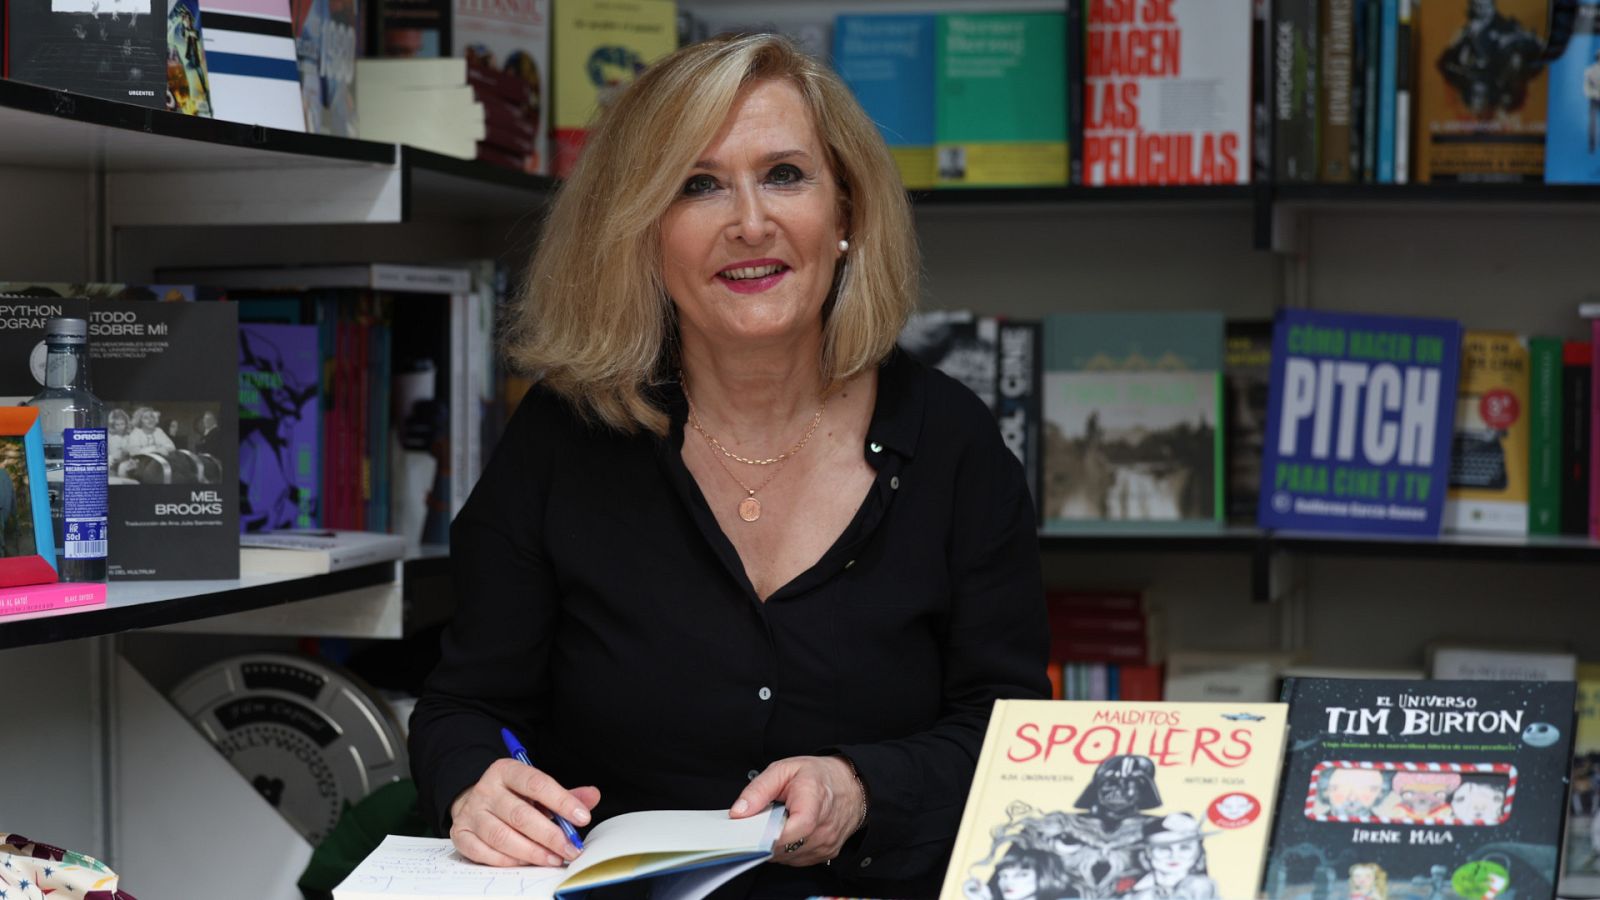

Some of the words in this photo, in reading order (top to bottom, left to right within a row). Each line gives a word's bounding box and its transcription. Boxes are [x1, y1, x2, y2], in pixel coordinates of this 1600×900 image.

[1085, 82, 1140, 130] LAS
[0, 305, 62, 316] PYTHON
[89, 324, 144, 336] SOBRE
[147, 321, 168, 336] MÍ!
[1278, 356, 1441, 467] PITCH
[1275, 462, 1329, 495] PARA
[1333, 466, 1381, 498] CINE
[1386, 470, 1399, 500] Y
[1405, 472, 1432, 502] TV
[191, 491, 222, 502] MEL
[155, 503, 222, 516] BROOKS
[1376, 696, 1393, 707] EL
[1398, 694, 1477, 708] UNIVERSO
[1092, 710, 1182, 727] MALDITOS
[1325, 706, 1391, 735] TIM
[1400, 708, 1524, 735] BURTON
[1007, 723, 1252, 768] SPOILERS
[221, 733, 331, 798] OLLYWOOD
[1352, 828, 1401, 843] IRENE
